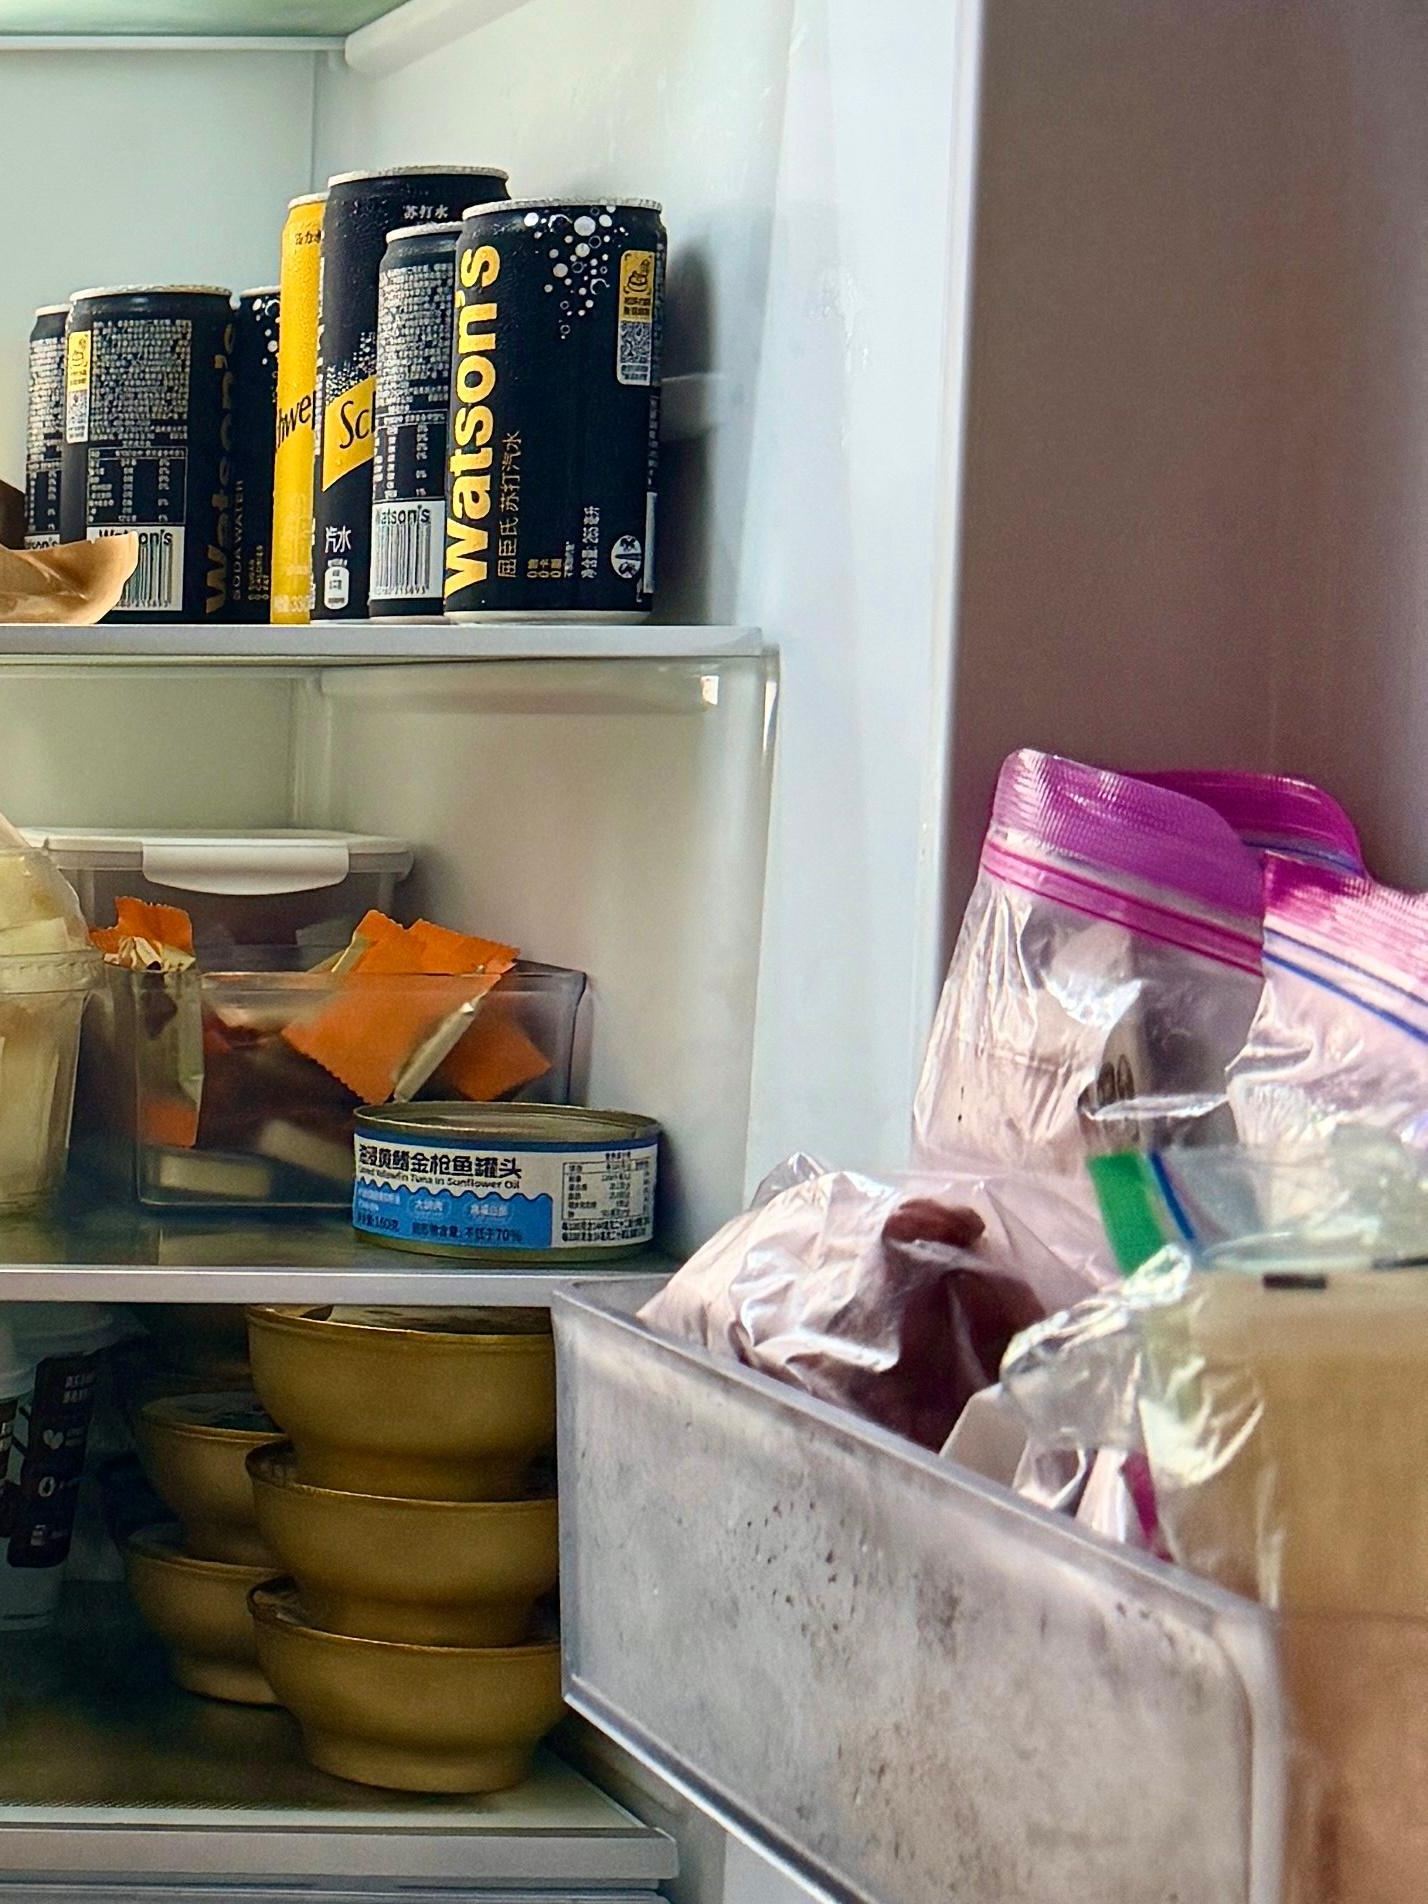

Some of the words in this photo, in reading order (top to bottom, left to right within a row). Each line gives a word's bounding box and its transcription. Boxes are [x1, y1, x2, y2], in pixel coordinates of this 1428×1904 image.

[445, 245, 500, 597] Watson's
[498, 431, 521, 513] 苏打汽水
[497, 517, 518, 578] 屈臣氏
[447, 1178, 501, 1189] Sunflower
[504, 1181, 521, 1190] Oil
